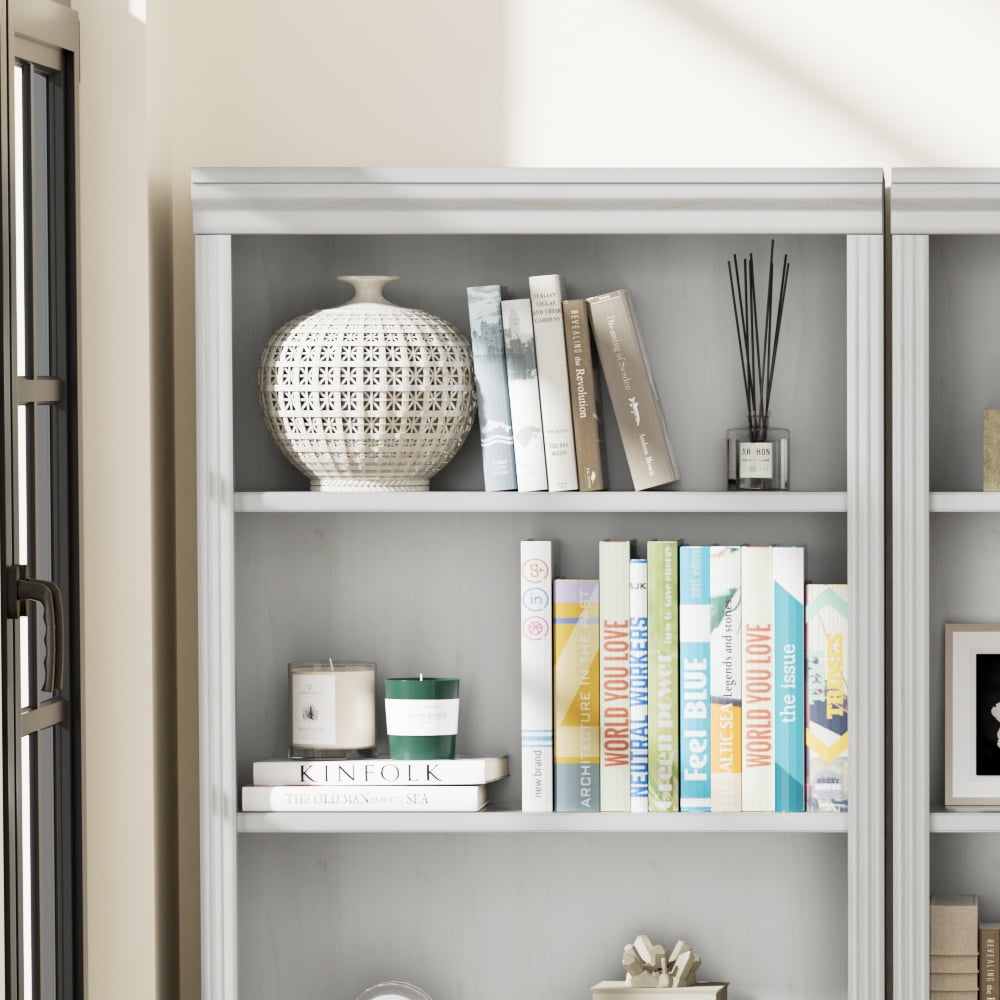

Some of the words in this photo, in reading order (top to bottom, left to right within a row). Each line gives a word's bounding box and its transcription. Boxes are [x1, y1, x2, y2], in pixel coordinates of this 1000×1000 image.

[570, 309, 582, 355] REVEALING
[574, 356, 582, 367] the
[575, 368, 588, 418] Revolution
[578, 590, 592, 628] PAST
[664, 585, 674, 608] save
[722, 599, 734, 633] stories
[580, 634, 592, 664] THE
[604, 620, 630, 660] LOVE
[664, 621, 674, 644] how
[722, 635, 734, 654] and
[746, 623, 772, 663] LOVE
[580, 668, 592, 684] IN
[631, 617, 648, 709] WORKERS
[722, 656, 738, 697] Legends
[779, 644, 796, 688] issue
[604, 664, 630, 706] YOU
[657, 650, 674, 732] power
[684, 658, 708, 719] BLUE
[746, 666, 772, 707] YOU
[720, 703, 734, 729] SEA
[778, 694, 796, 724] the
[580, 688, 592, 808] ARCHITECTURE
[604, 708, 630, 768] WORLD
[631, 714, 648, 798] NEUTRAL
[684, 730, 708, 782] Feel
[746, 708, 772, 769] WORLD
[300, 764, 443, 782] KINFOLK
[534, 750, 542, 779] brand
[656, 734, 674, 811] Green
[286, 792, 311, 805] THE
[314, 792, 340, 805] OLD
[342, 792, 369, 805] MAN
[406, 792, 430, 805] SEA
[534, 780, 542, 798] new
[986, 938, 995, 982] REVEALING
